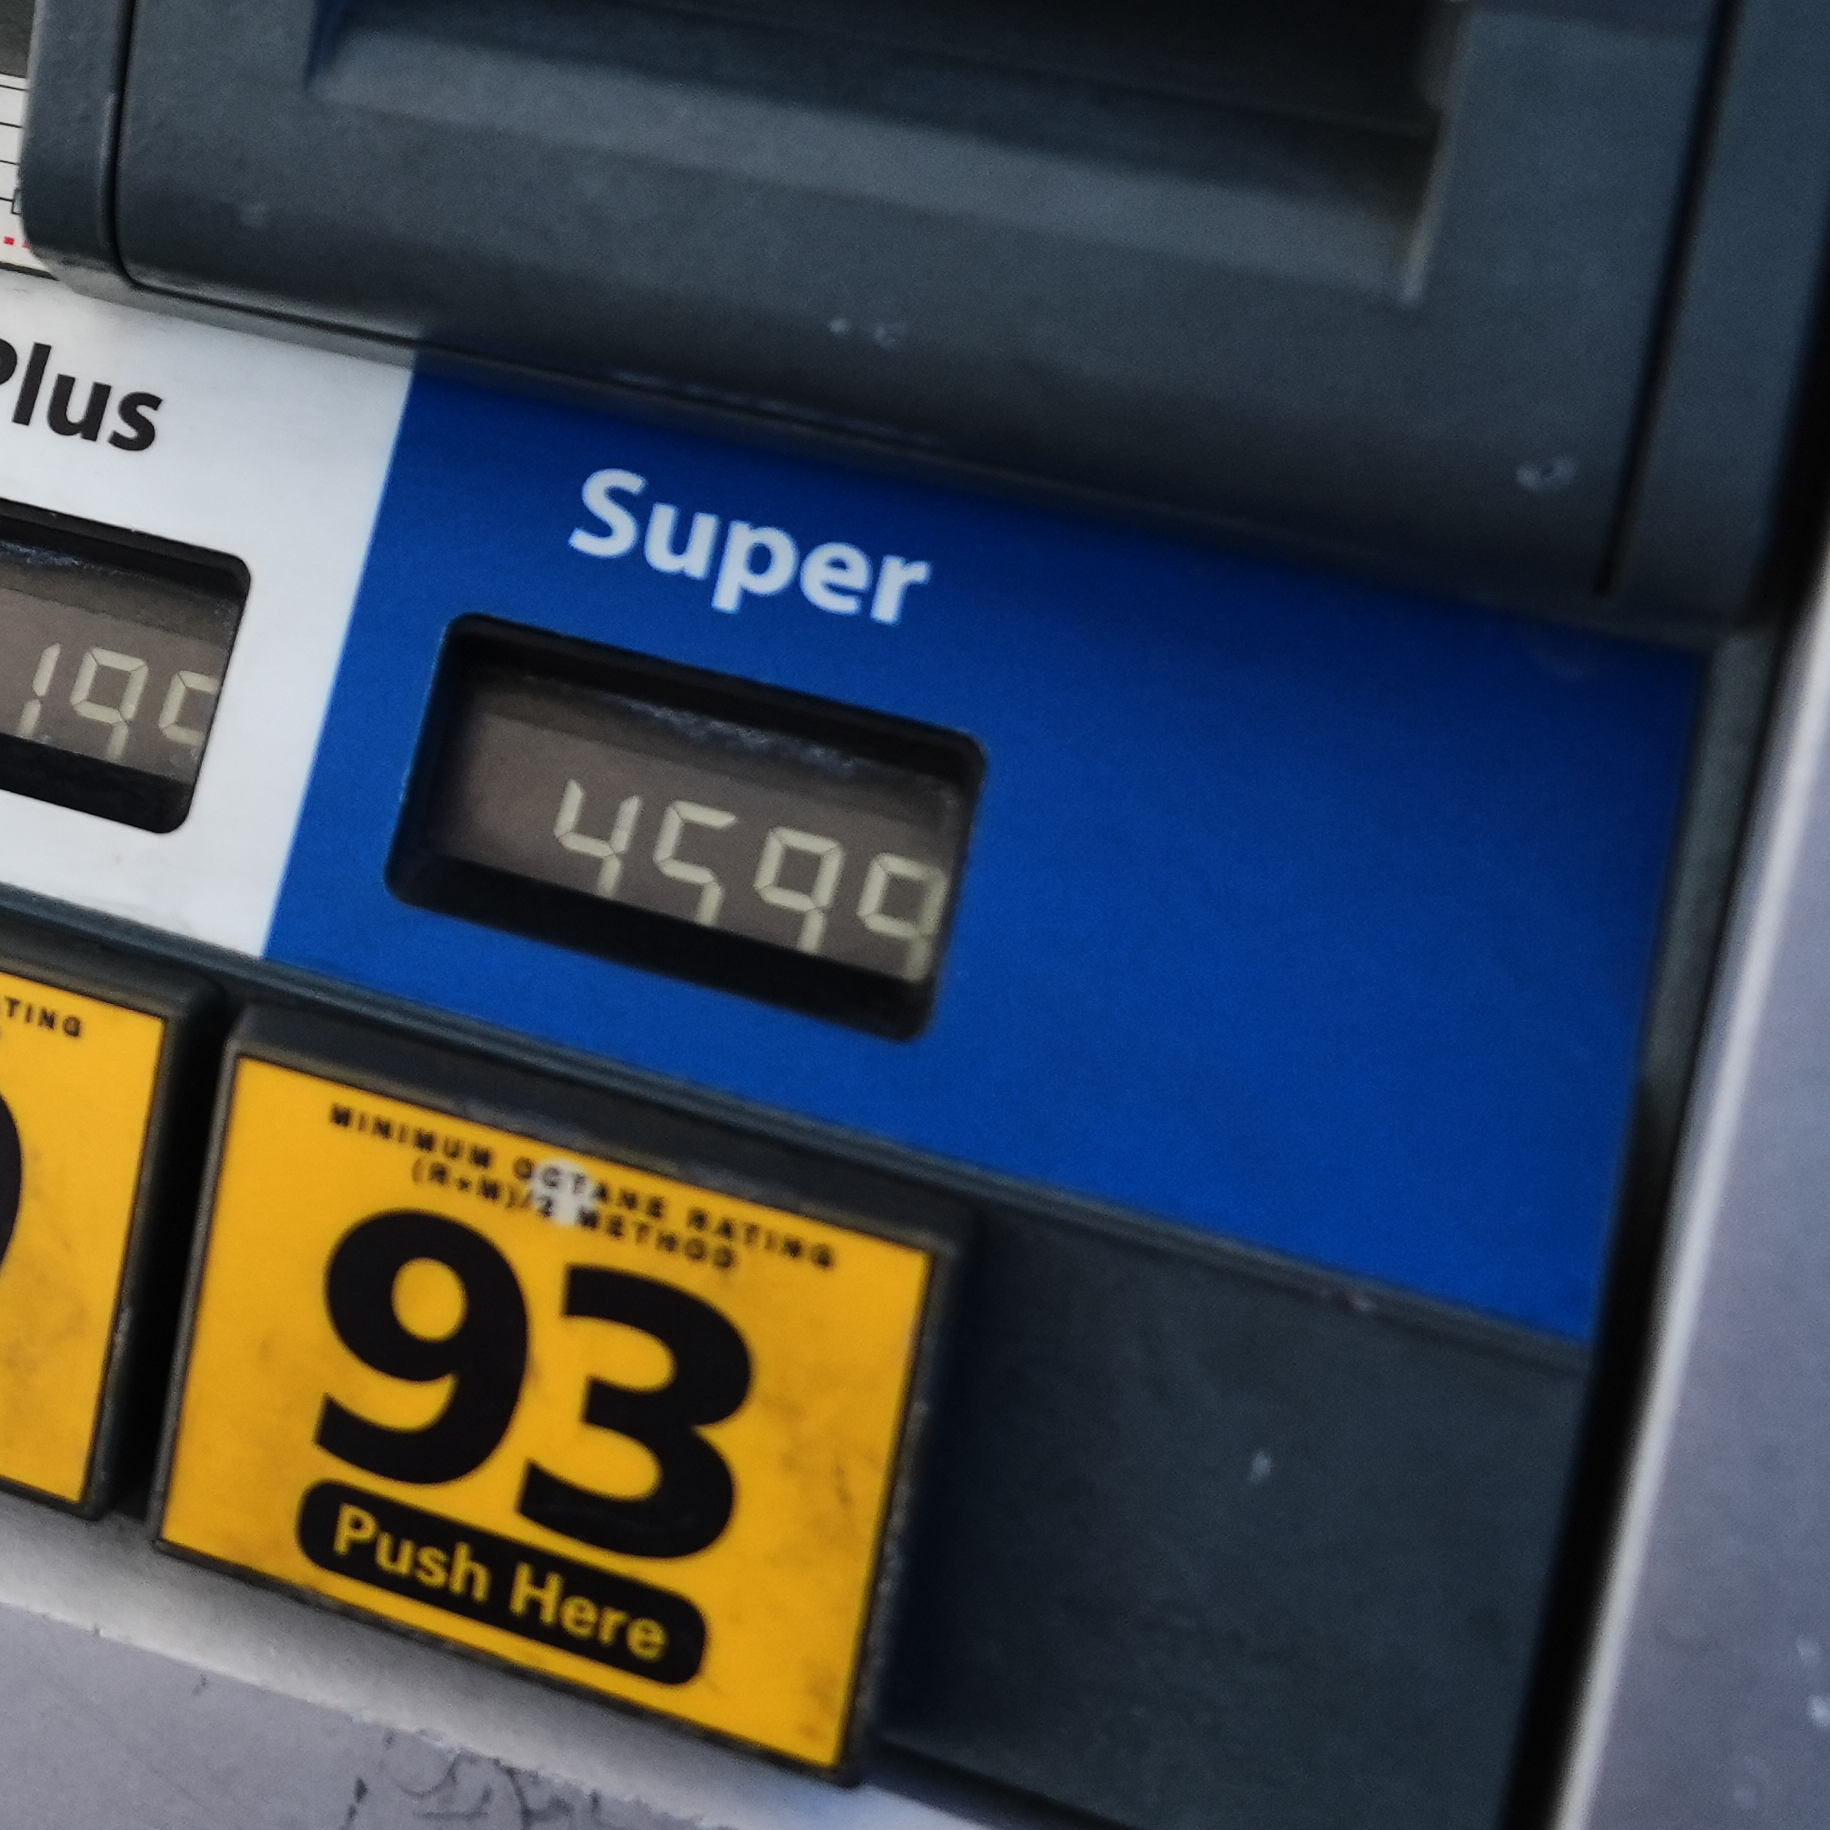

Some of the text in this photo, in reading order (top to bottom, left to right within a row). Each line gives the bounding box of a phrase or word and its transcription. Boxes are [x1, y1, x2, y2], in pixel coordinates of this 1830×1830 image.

[567, 467, 932, 625] Super
[329, 1102, 837, 1270] MINIMUM OCTANE RATING
[577, 1205, 738, 1270] METHOD
[314, 1207, 754, 1560] 93
[333, 1502, 669, 1661] Push Here
